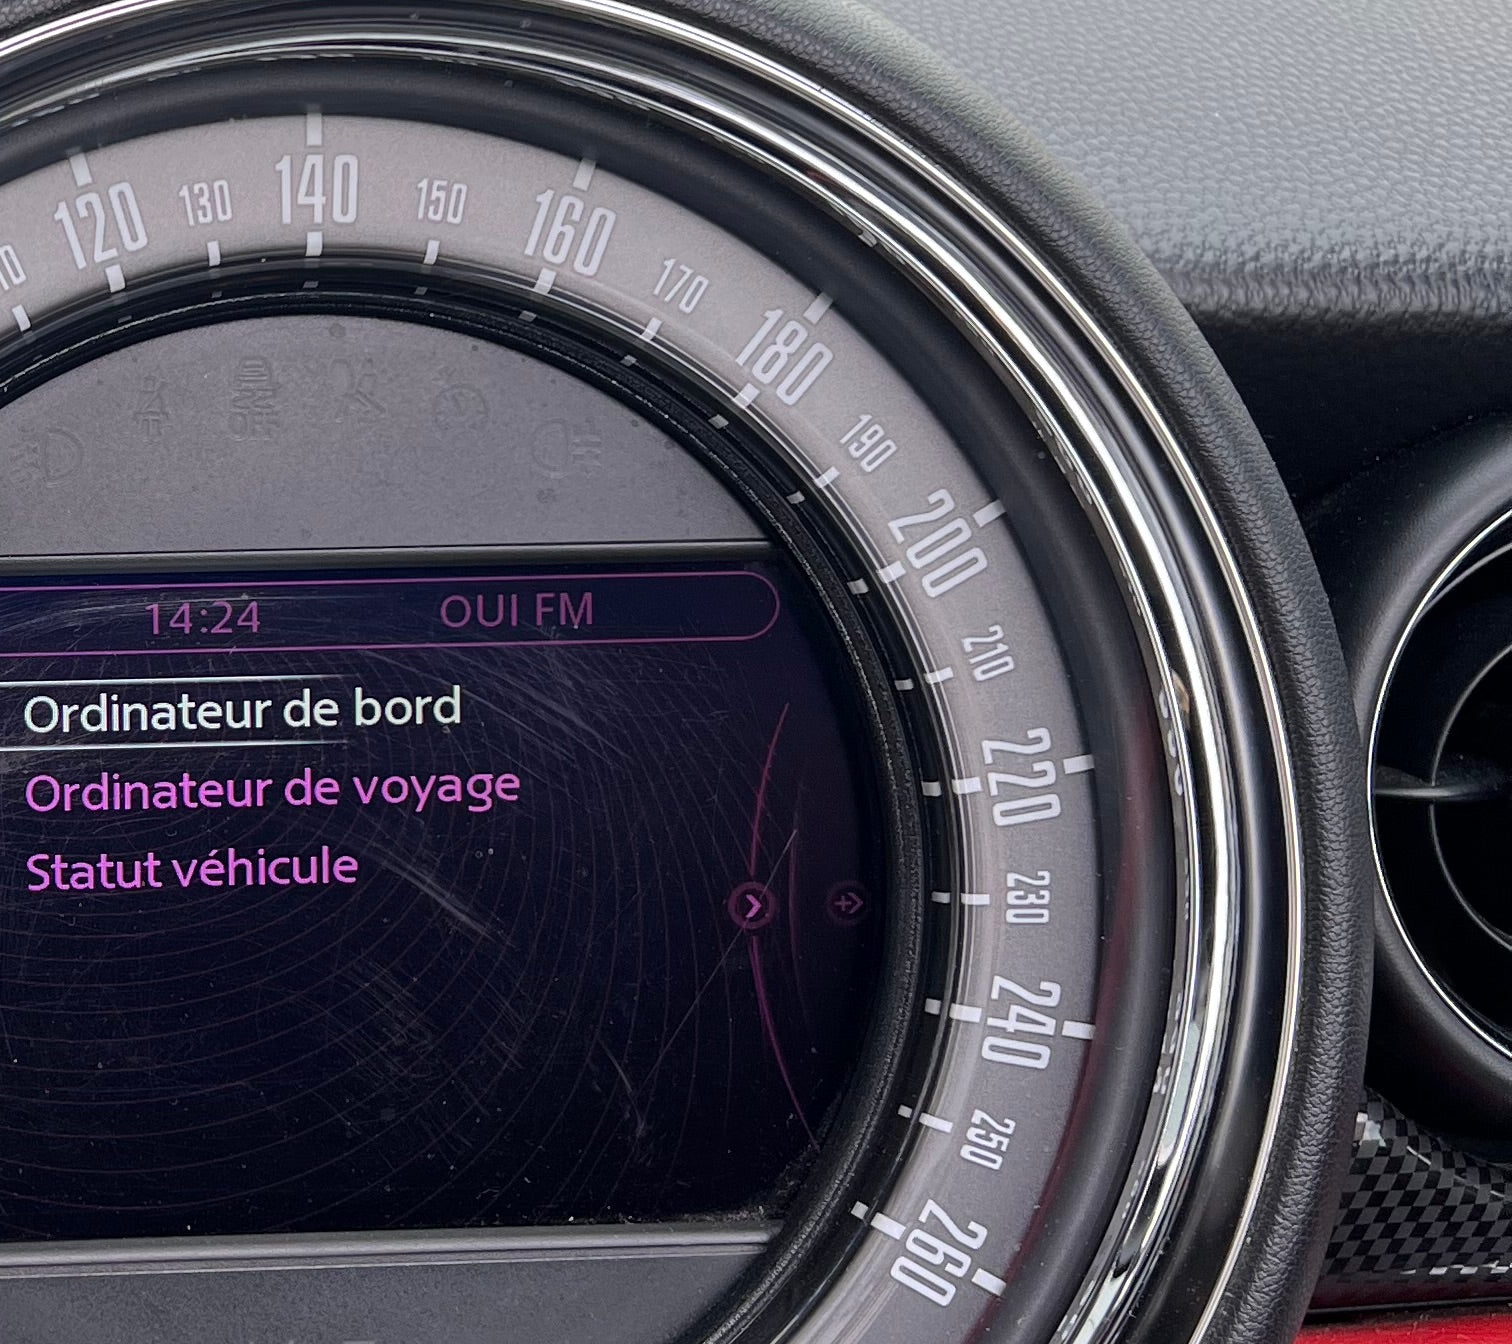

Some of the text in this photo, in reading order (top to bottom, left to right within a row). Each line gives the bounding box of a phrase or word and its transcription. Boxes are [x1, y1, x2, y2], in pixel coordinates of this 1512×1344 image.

[179, 180, 232, 227] 130
[274, 153, 359, 224] 140
[416, 179, 467, 225] 150
[54, 182, 148, 269] 120
[523, 189, 617, 278] 160
[650, 259, 710, 313] 170
[735, 307, 834, 406] 180
[839, 414, 897, 473] 190
[888, 488, 989, 598] 200
[144, 601, 263, 636] 14:24
[440, 592, 595, 627] OUI FM
[961, 625, 1014, 682] 210
[23, 685, 463, 736] Ordinateur de bord
[24, 766, 522, 814] Ordinateur de voyage
[980, 726, 1062, 827] 220
[25, 844, 360, 892] Statut véhicule
[1005, 870, 1051, 925] 230
[981, 980, 1062, 1070] 240
[960, 1109, 1017, 1171] 250
[890, 1199, 989, 1307] 260
